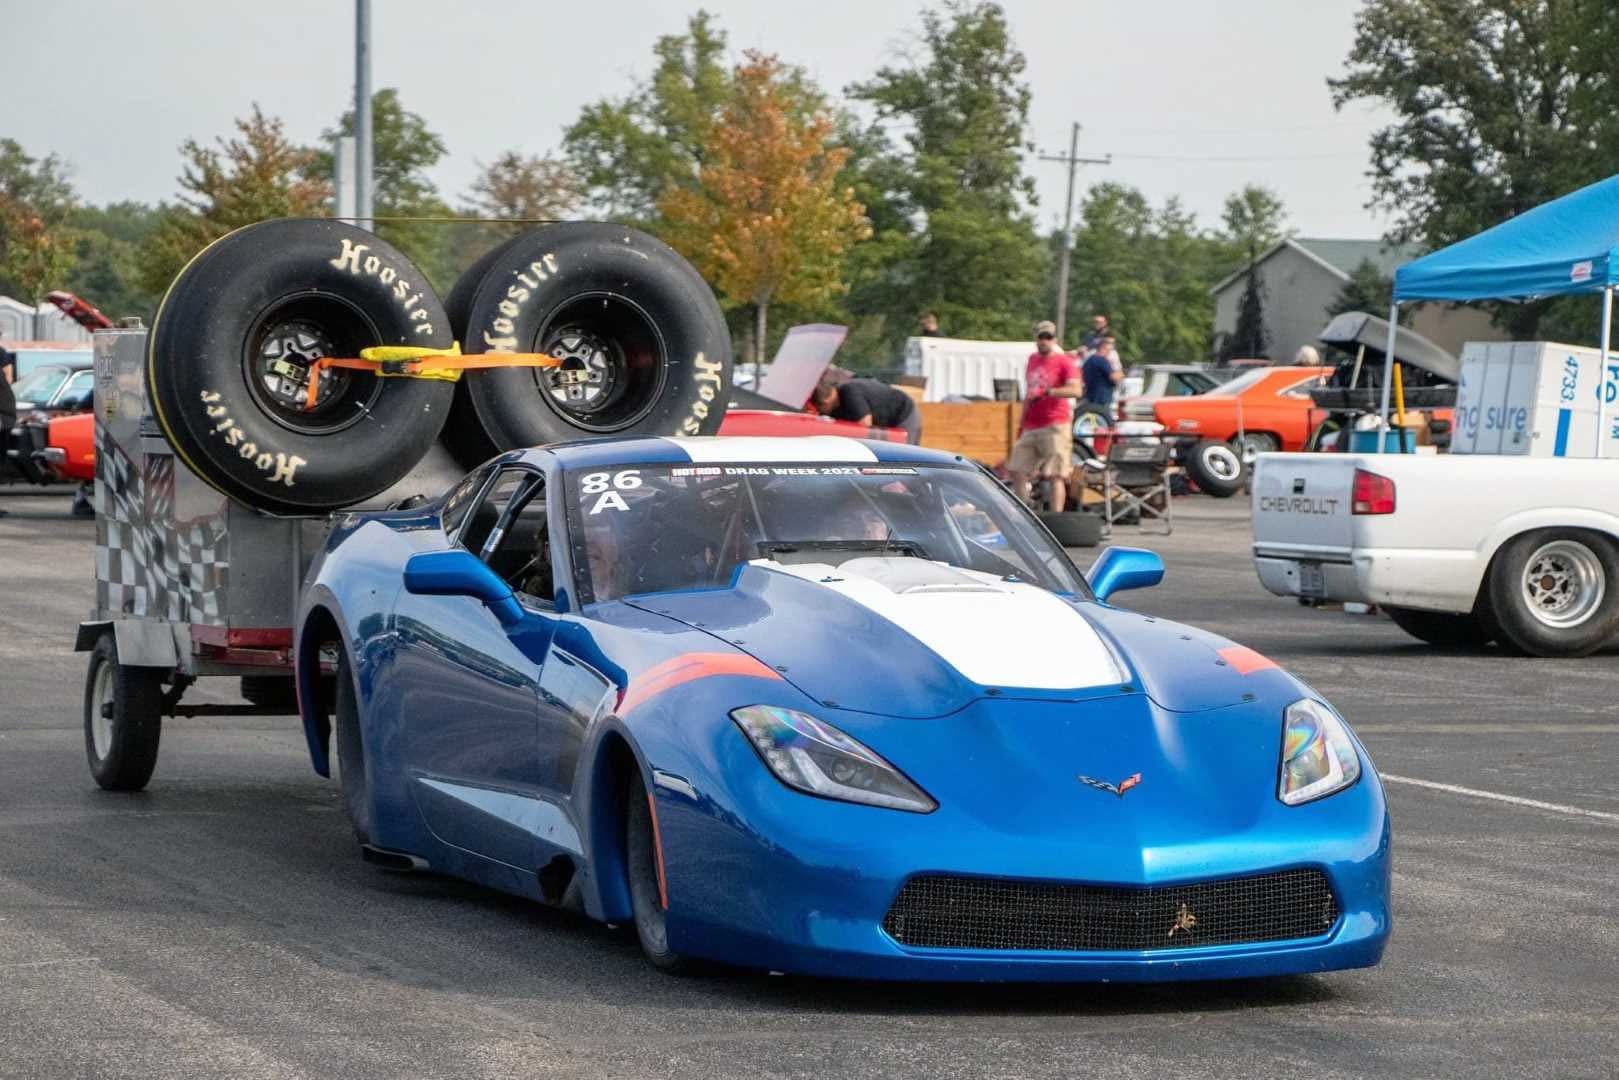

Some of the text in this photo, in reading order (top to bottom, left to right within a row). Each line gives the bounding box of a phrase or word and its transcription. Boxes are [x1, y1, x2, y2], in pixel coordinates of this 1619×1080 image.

[329, 239, 433, 335] Hoosier
[483, 253, 559, 355] Hoosier
[674, 351, 723, 436] Hoos
[1486, 405, 1527, 430] sure
[200, 389, 307, 487] Hoosier
[582, 469, 643, 494] 86
[724, 467, 769, 476] DRAG
[771, 467, 818, 476] WEEK
[820, 467, 861, 476] 2021
[589, 490, 631, 515] A
